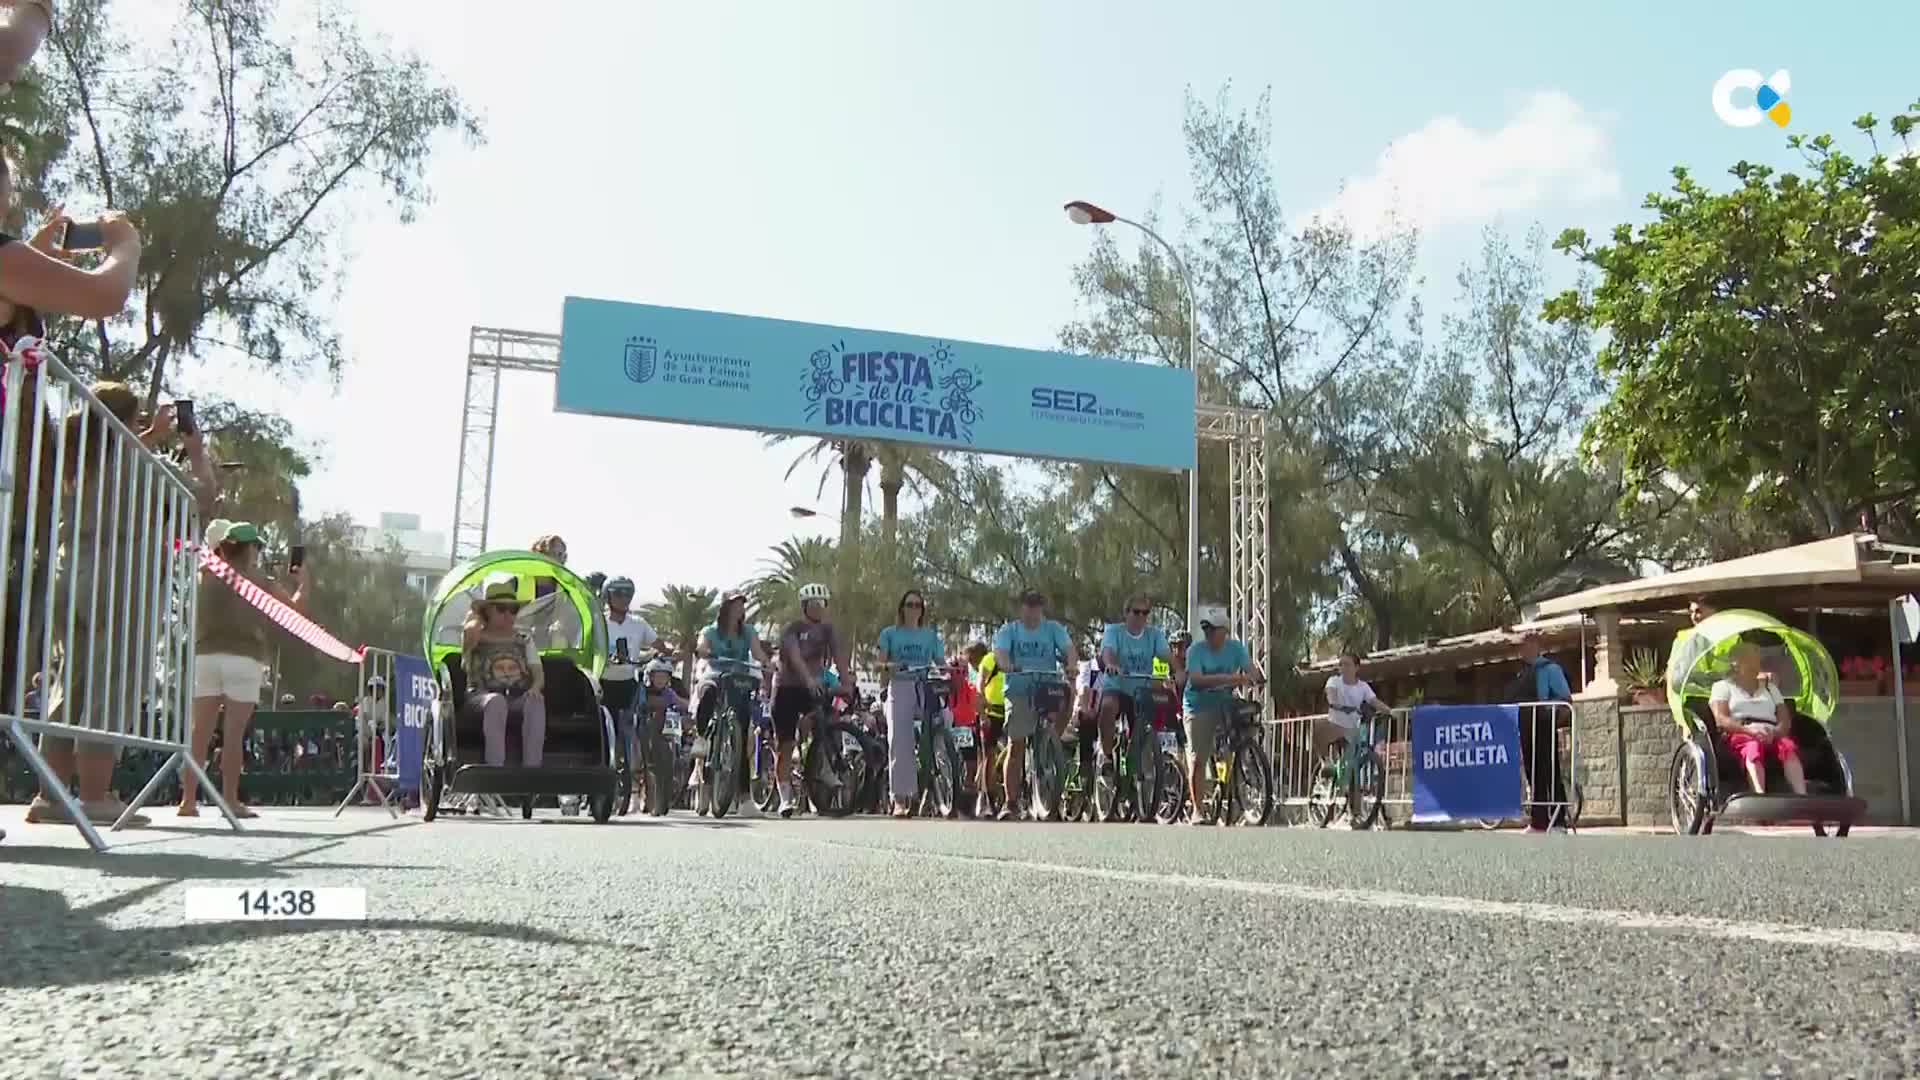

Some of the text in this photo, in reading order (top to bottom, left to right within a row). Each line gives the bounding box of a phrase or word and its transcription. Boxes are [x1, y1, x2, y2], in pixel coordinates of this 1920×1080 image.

[663, 350, 750, 368] Ayuntamiento
[663, 360, 677, 371] de
[684, 362, 703, 373] Las
[842, 351, 933, 390] FIESTA
[663, 373, 750, 391] de Gran Canaria
[869, 376, 914, 403] de la
[825, 398, 958, 440] BICICLETA
[1435, 721, 1493, 745] FIESTA
[1423, 743, 1508, 769] BICICLETA
